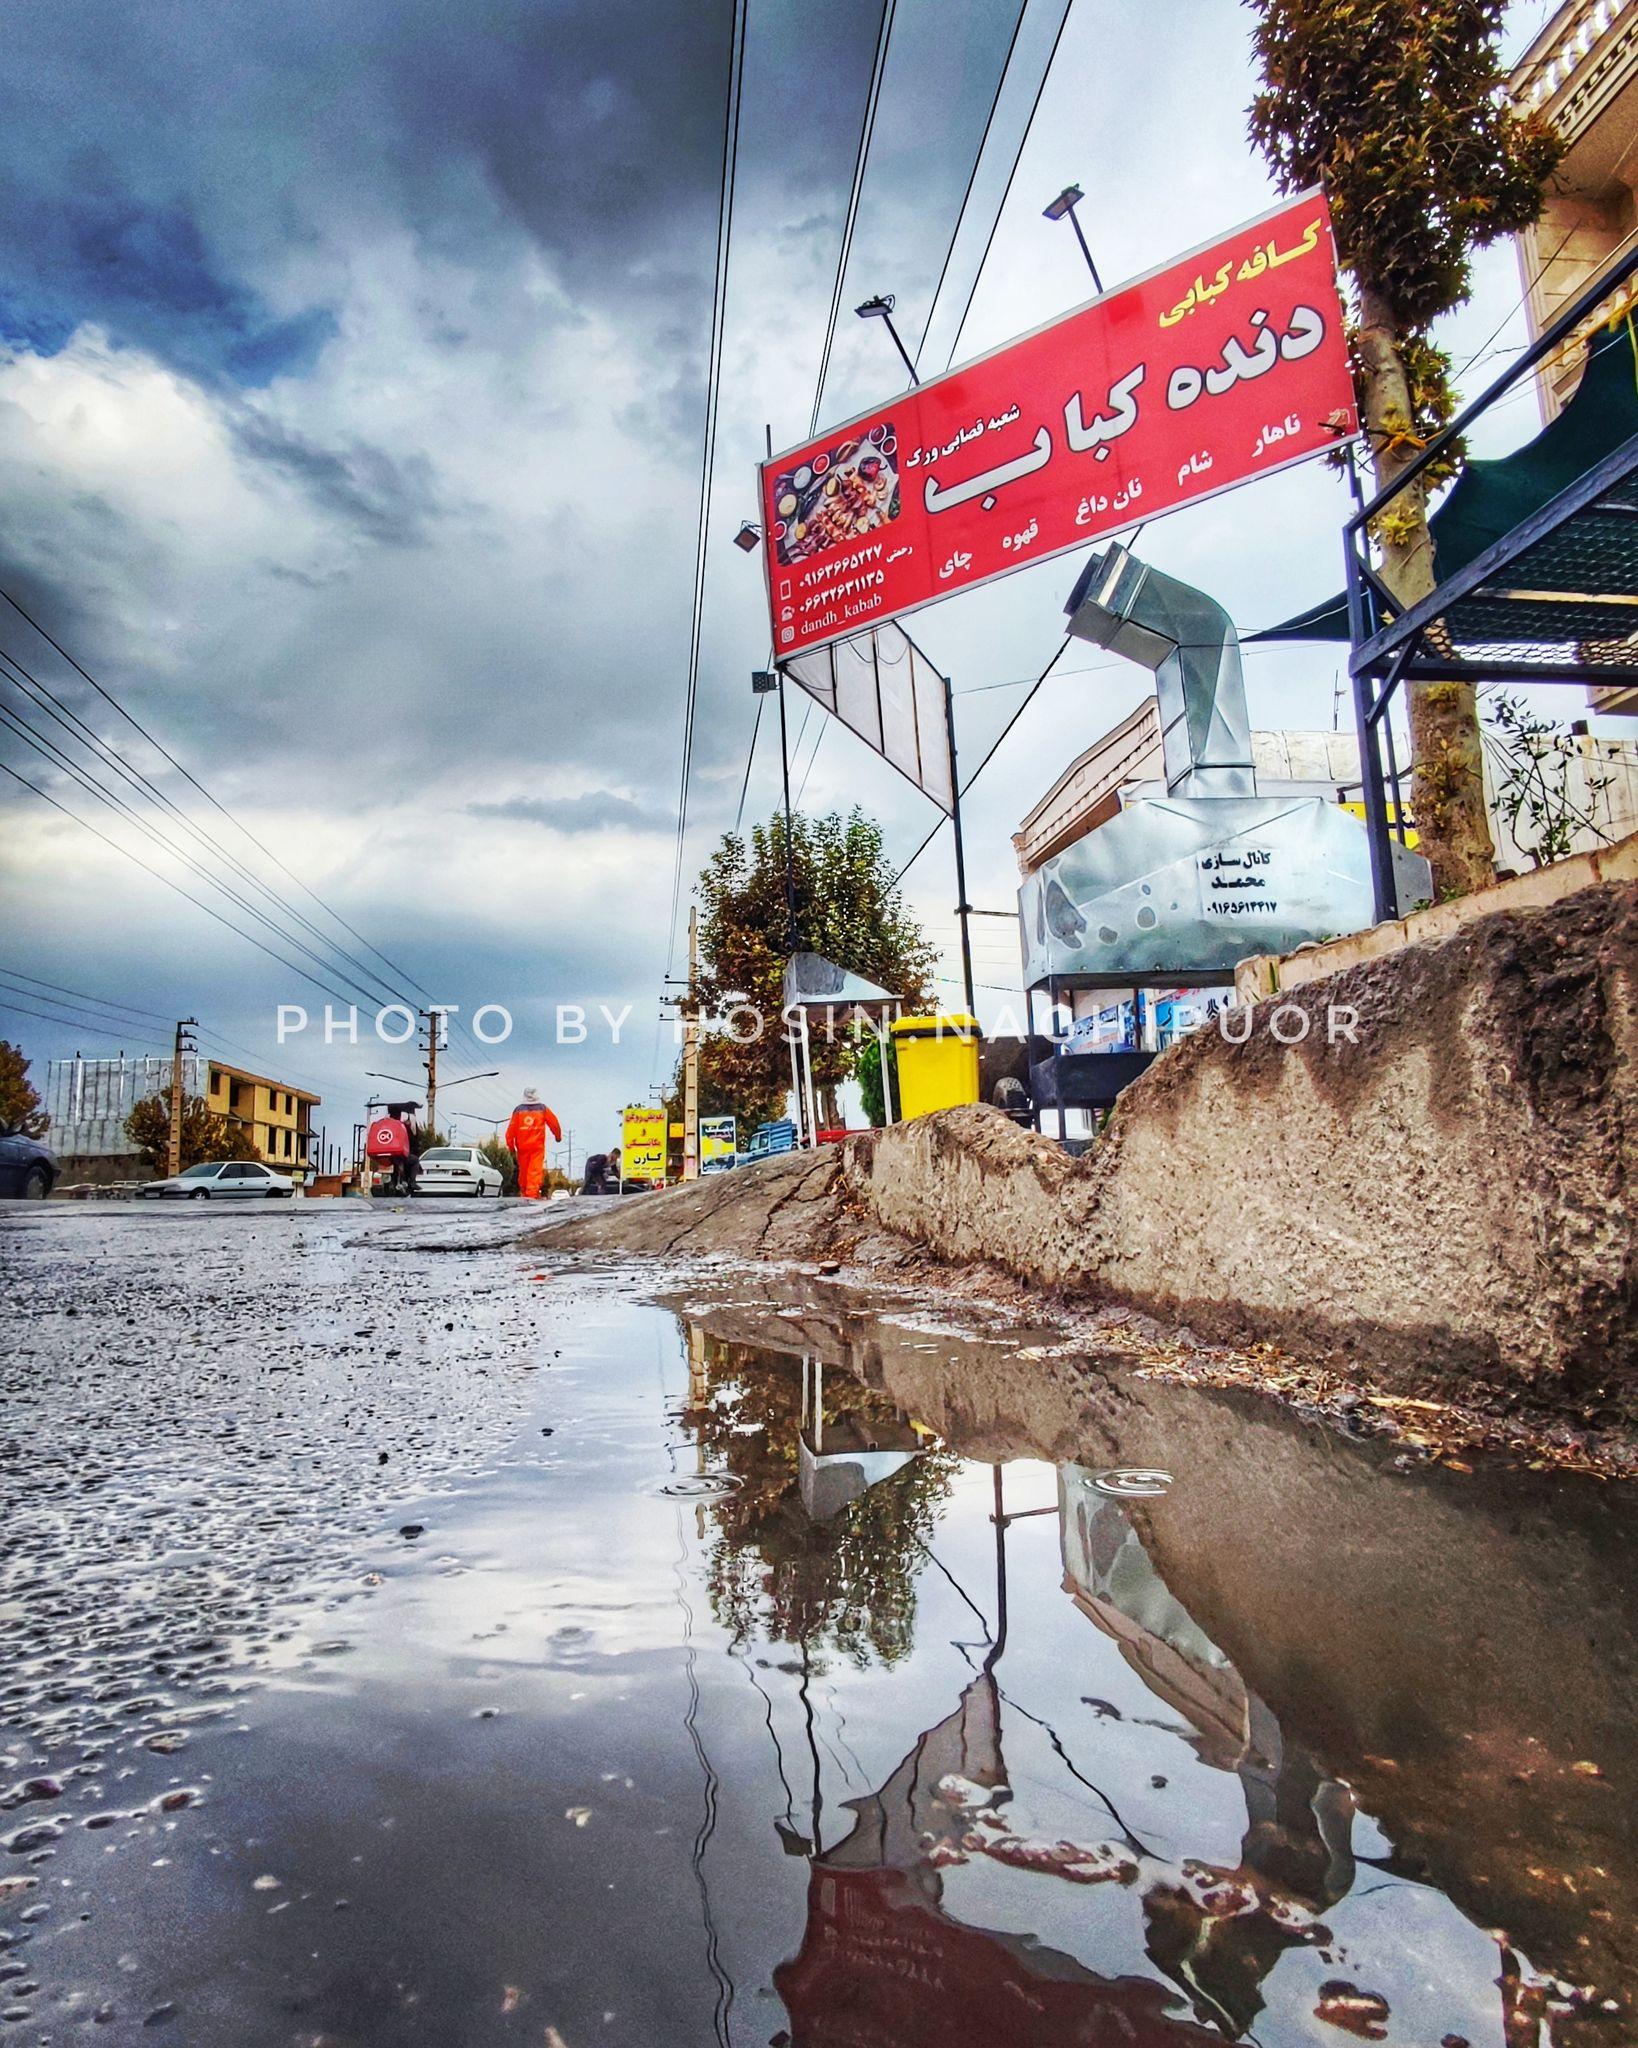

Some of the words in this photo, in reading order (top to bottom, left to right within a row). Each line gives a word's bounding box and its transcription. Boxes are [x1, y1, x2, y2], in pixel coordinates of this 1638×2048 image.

[1236, 218, 1322, 281] کافه
[1158, 261, 1233, 328] کبابی
[1166, 304, 1326, 411] دنده
[987, 404, 1020, 432] شعبه
[923, 362, 1146, 514] کباب
[941, 419, 985, 457] قصابی
[1251, 413, 1301, 458] ناهار
[1177, 449, 1214, 486] شام
[1075, 495, 1108, 526] داغ
[1113, 477, 1143, 511] نان
[1002, 518, 1039, 552] قهوه
[938, 550, 973, 579] چای
[800, 593, 882, 635] dandh_kabab
[1201, 852, 1241, 870] سازی
[1243, 850, 1271, 869] کانال
[1211, 876, 1266, 889] محمد
[633, 1152, 662, 1164] کارن
